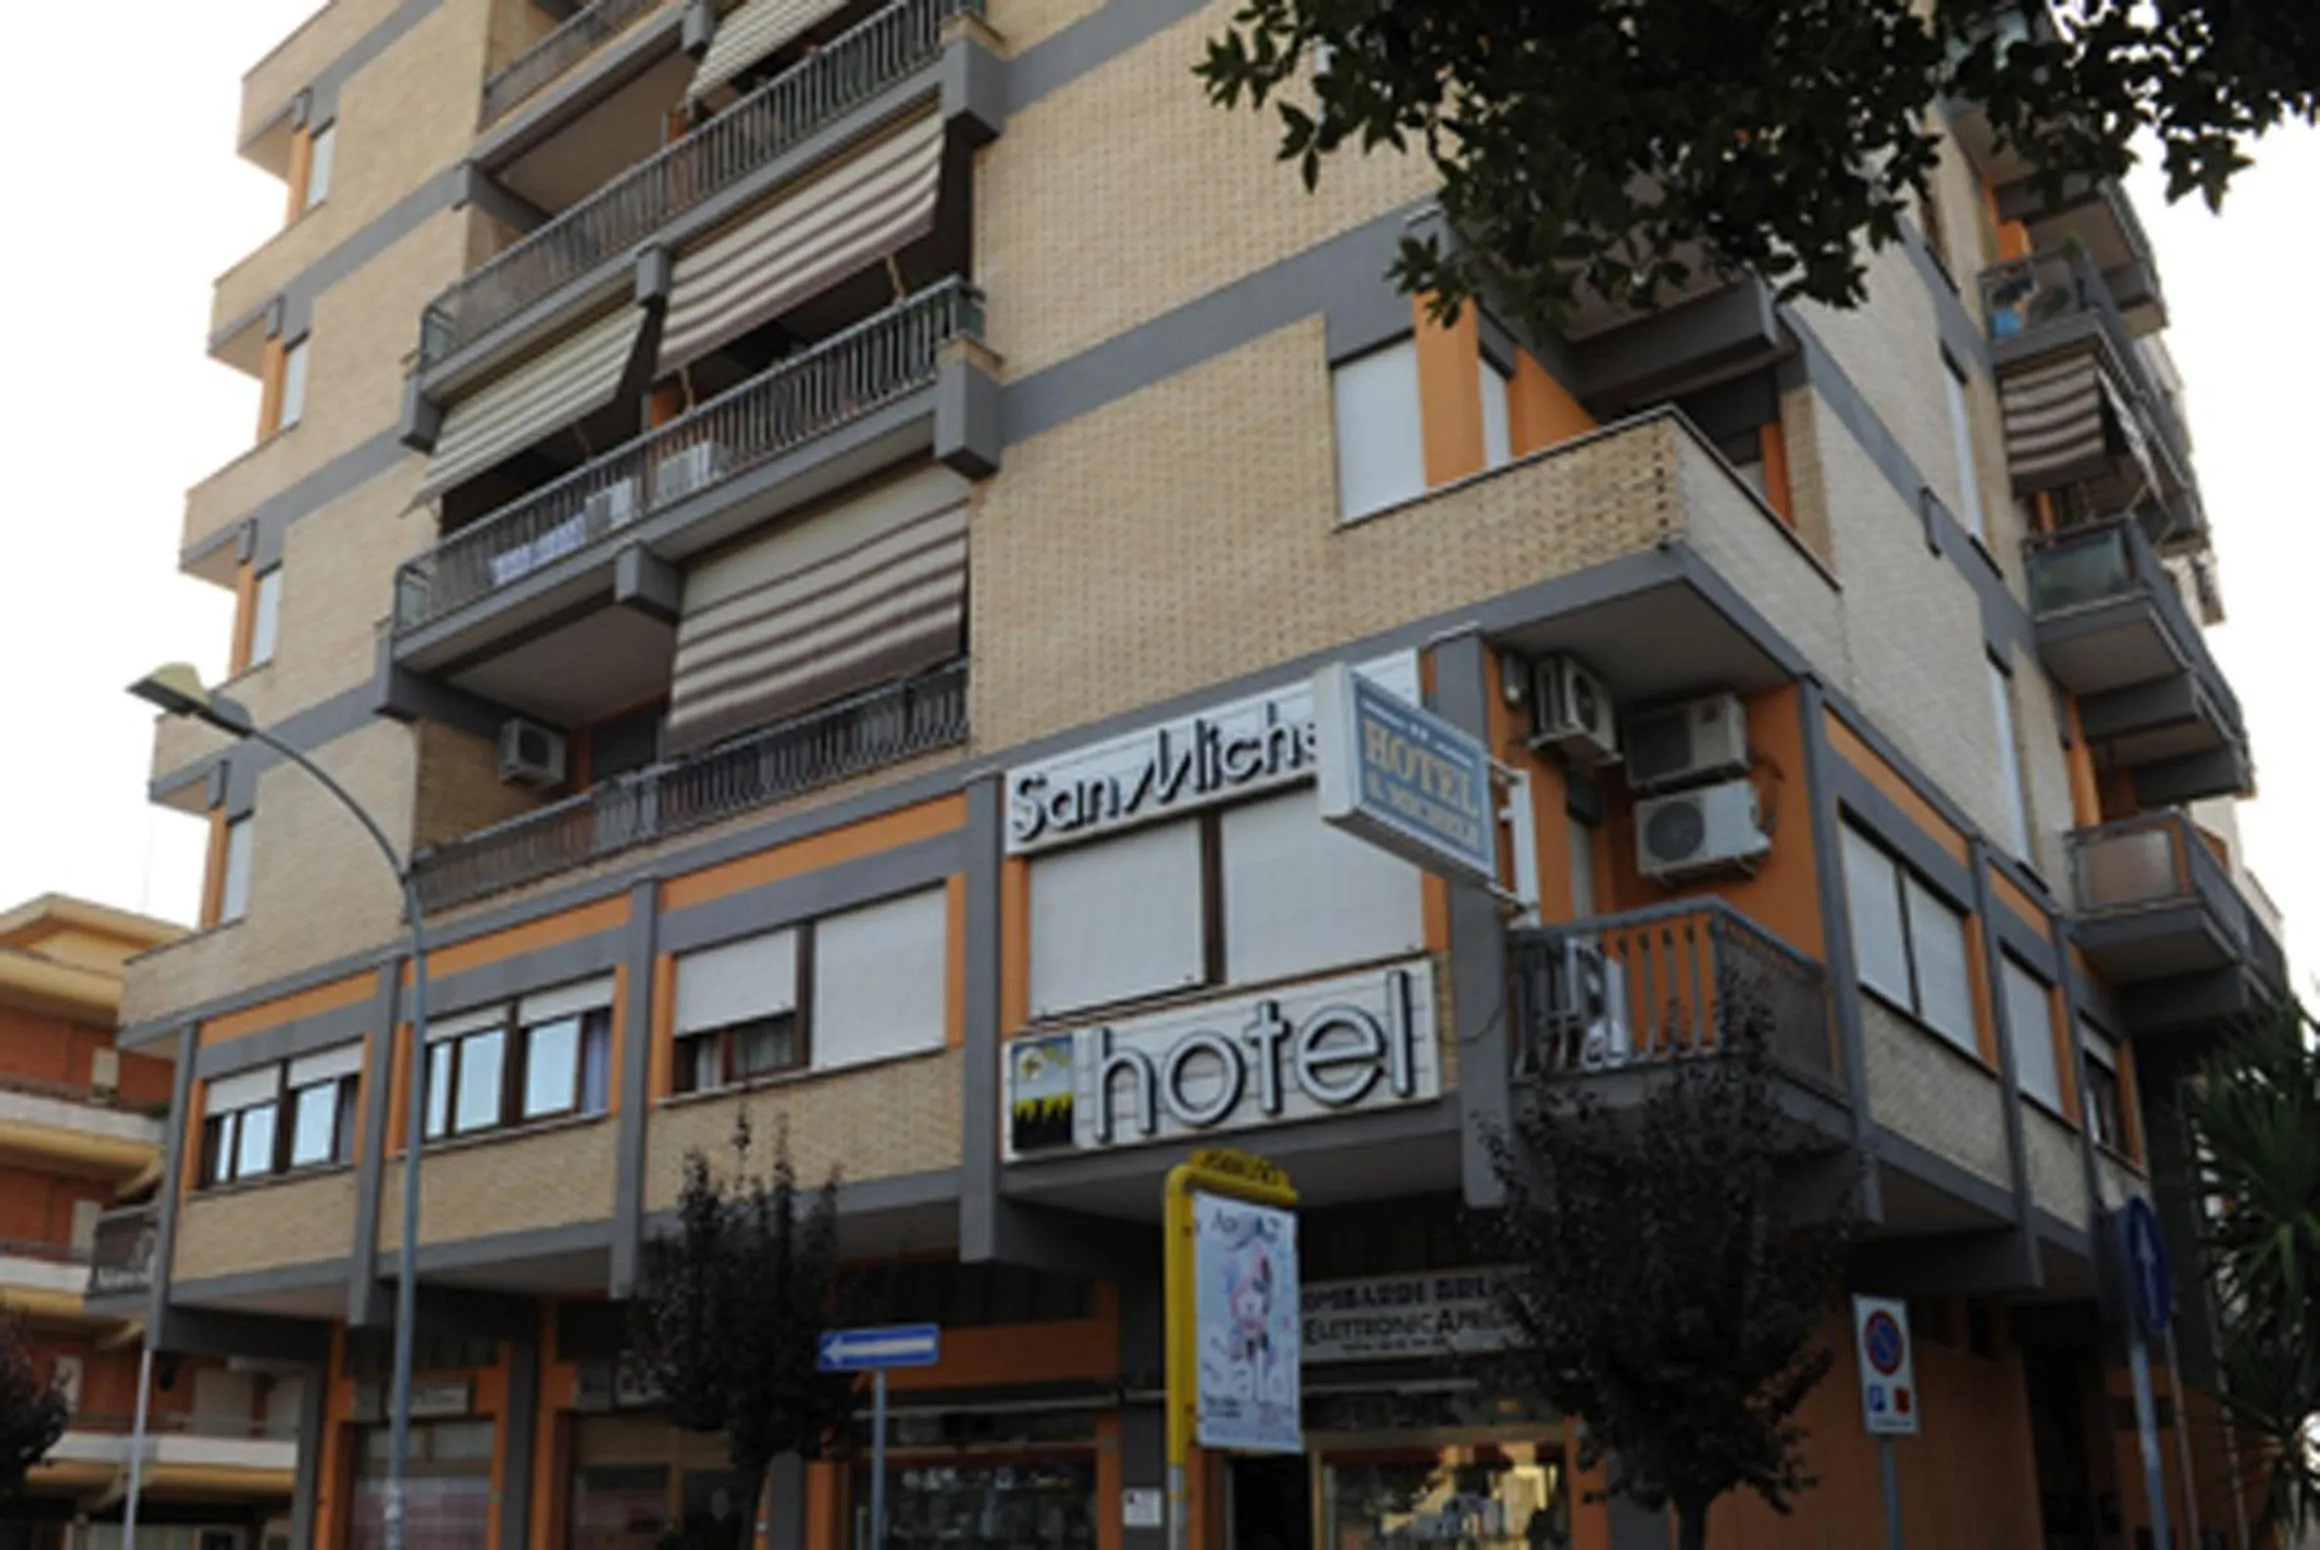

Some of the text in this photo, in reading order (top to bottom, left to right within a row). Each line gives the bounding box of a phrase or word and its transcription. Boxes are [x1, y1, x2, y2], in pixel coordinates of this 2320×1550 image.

[1010, 700, 1317, 843] San Mich
[1364, 718, 1480, 819] HOTEL
[1091, 968, 1418, 1144] hotel
